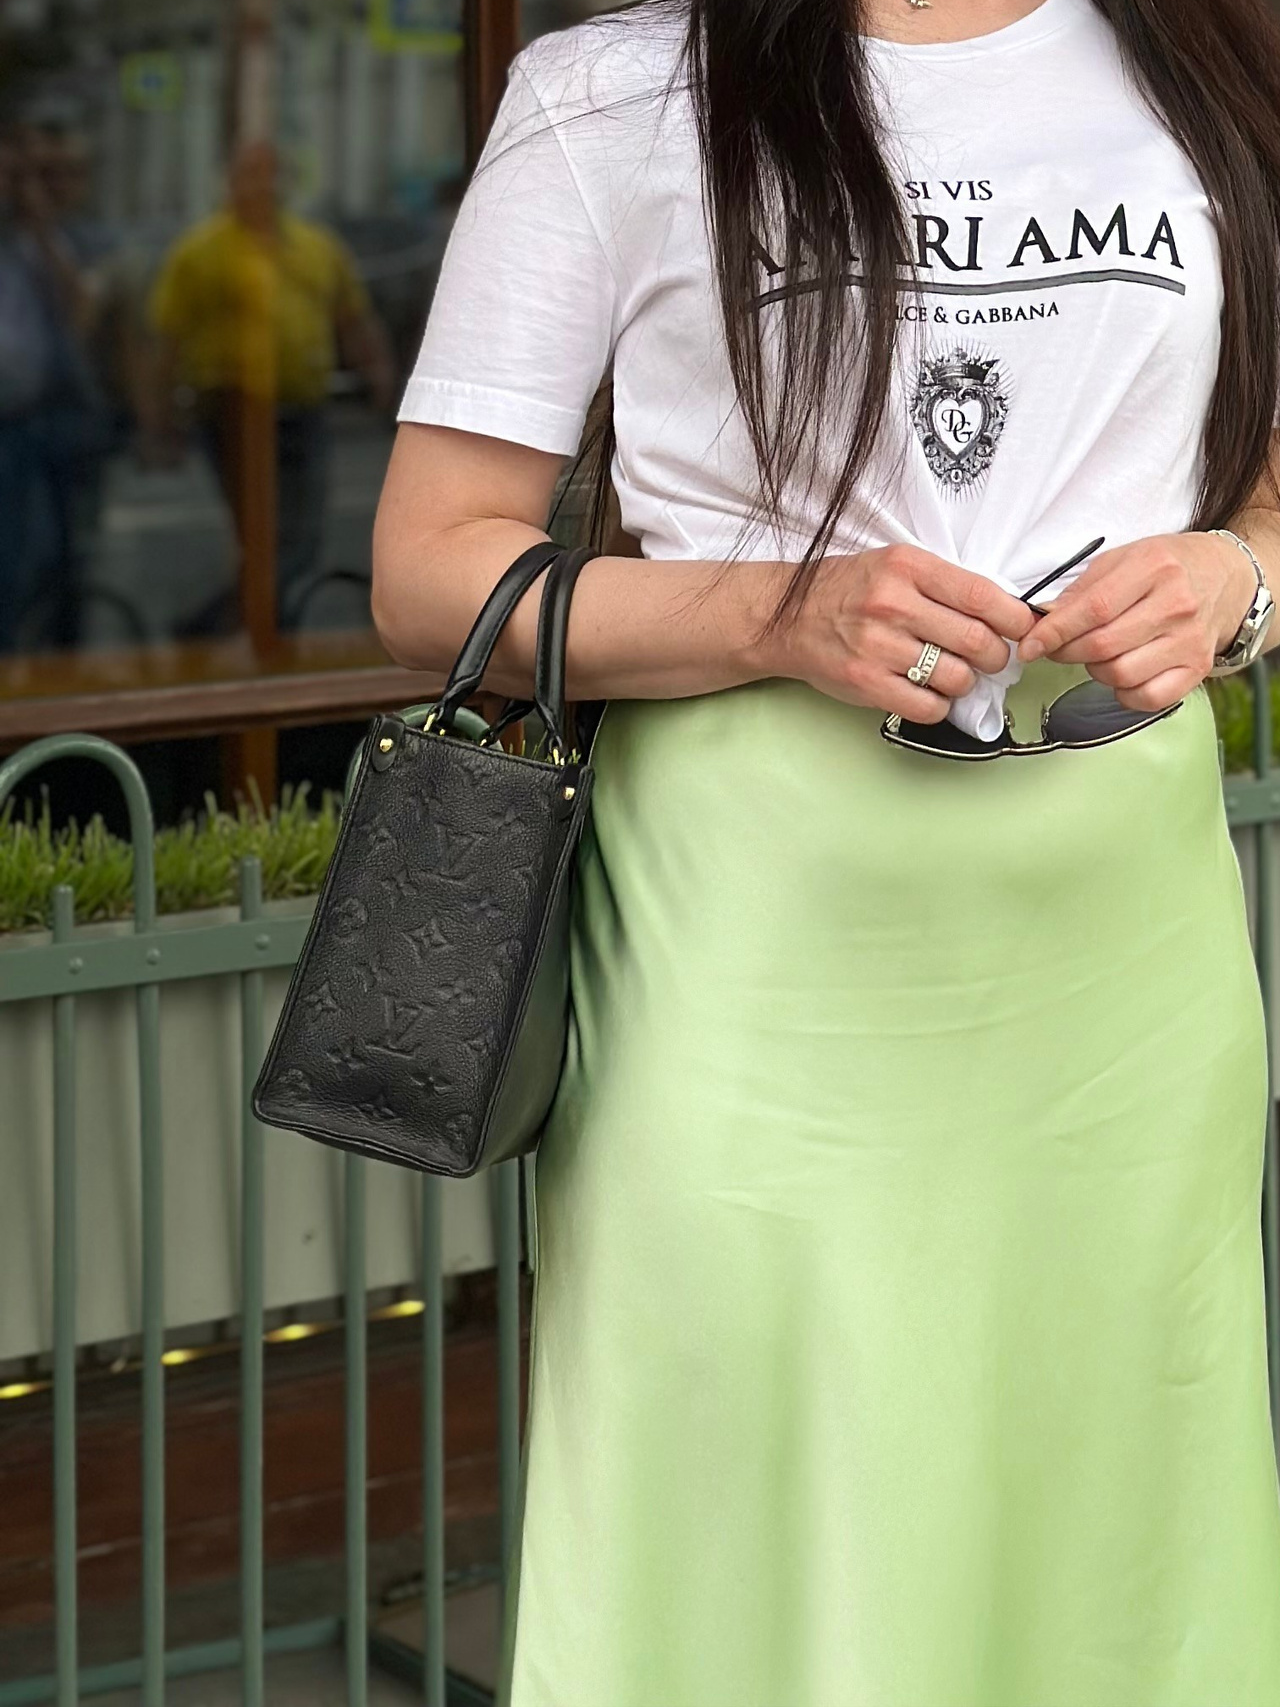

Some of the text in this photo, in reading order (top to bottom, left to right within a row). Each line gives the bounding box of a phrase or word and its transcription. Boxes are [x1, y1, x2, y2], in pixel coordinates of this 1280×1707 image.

[904, 179, 994, 201] SI VIS
[1006, 202, 1185, 270] AMA
[933, 305, 949, 324] &
[955, 301, 1060, 325] GABBANA
